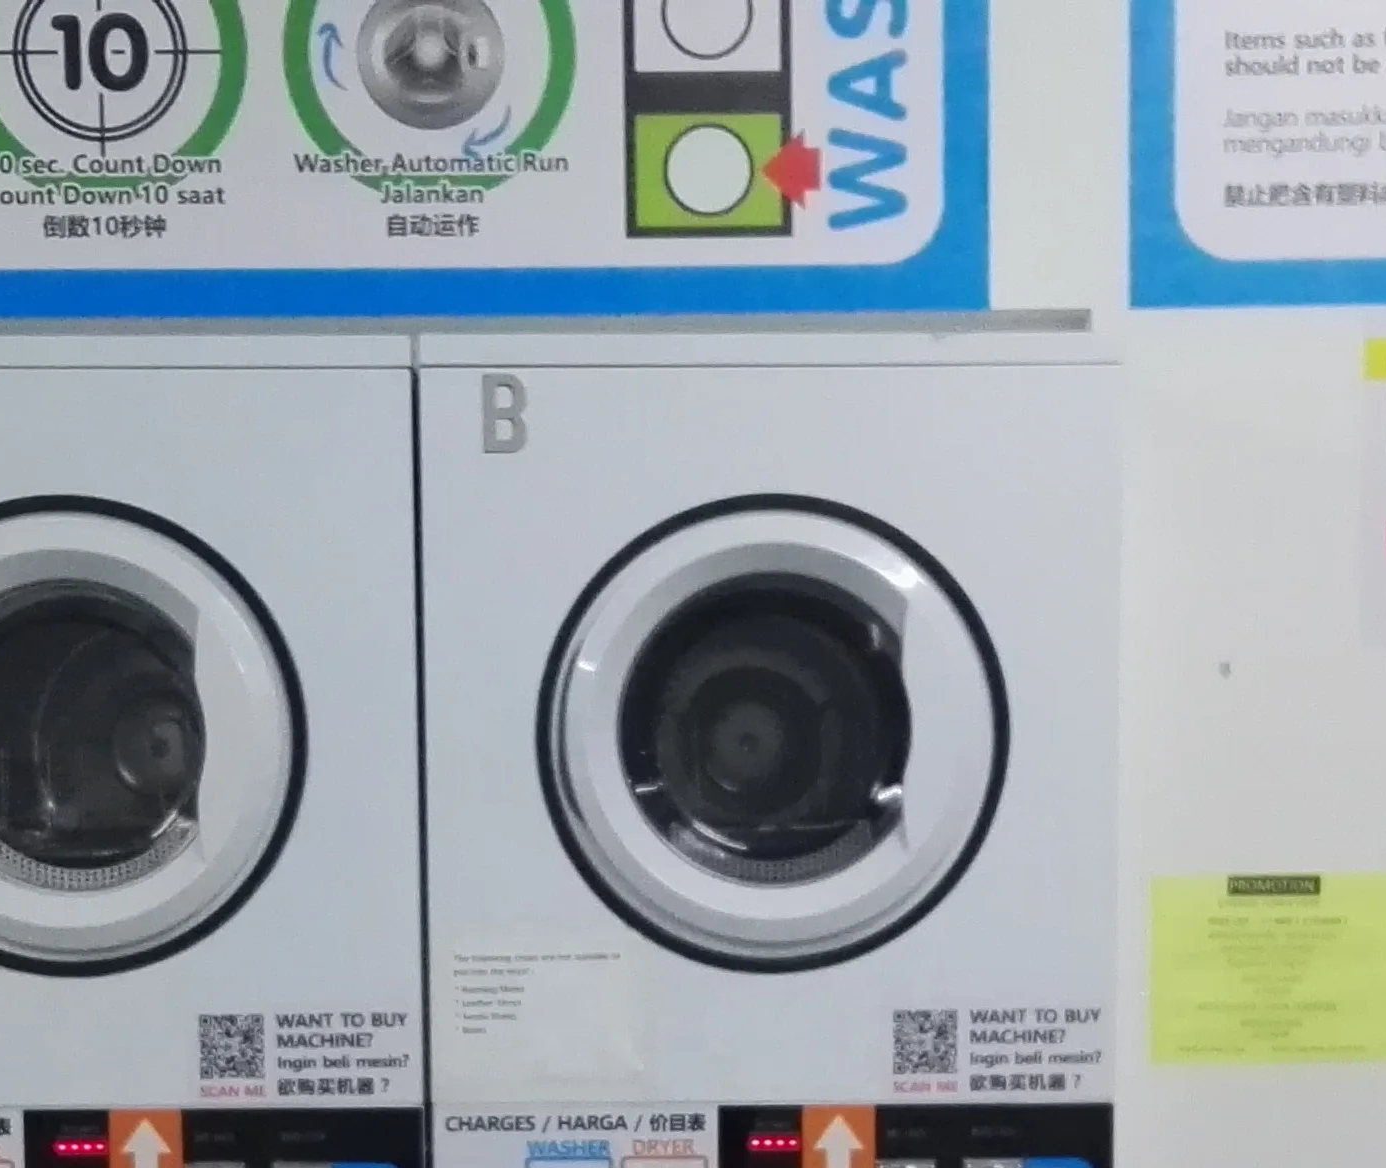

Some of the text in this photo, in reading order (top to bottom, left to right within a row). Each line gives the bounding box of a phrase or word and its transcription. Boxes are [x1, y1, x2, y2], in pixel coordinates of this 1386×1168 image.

[1224, 29, 1285, 51] Items
[1295, 28, 1344, 49] such
[1353, 32, 1375, 48] as
[50, 14, 149, 92] 10
[1224, 53, 1299, 77] should
[1307, 54, 1345, 75] not
[1353, 52, 1381, 75] be
[21, 155, 65, 175] sec.
[73, 153, 145, 174] Count
[153, 153, 222, 174] Down
[295, 152, 569, 174] Washer Automatic Run
[64, 184, 132, 206] Down
[142, 184, 170, 204] 10
[177, 183, 226, 205] saat
[380, 182, 484, 205] Jalankan
[43, 214, 167, 239] 倒数10秒钟
[386, 214, 480, 238] 自动运作
[481, 373, 528, 454] B
[276, 1012, 408, 1027] WANT TO BUY
[970, 1008, 1101, 1024] WANT TO BUY
[277, 1033, 373, 1048] MACHINE?
[970, 1029, 1066, 1044] MACHINE?
[322, 1054, 350, 1069] beli
[356, 1053, 409, 1069] mesin?
[1014, 1050, 1102, 1066] beli mesin?
[200, 1085, 239, 1098] SCAN
[893, 1081, 932, 1093] SCAN
[445, 1113, 706, 1133] CHARGES / HARGA / 价目表
[526, 1140, 611, 1157] WASHER
[632, 1139, 695, 1155] DRYER
